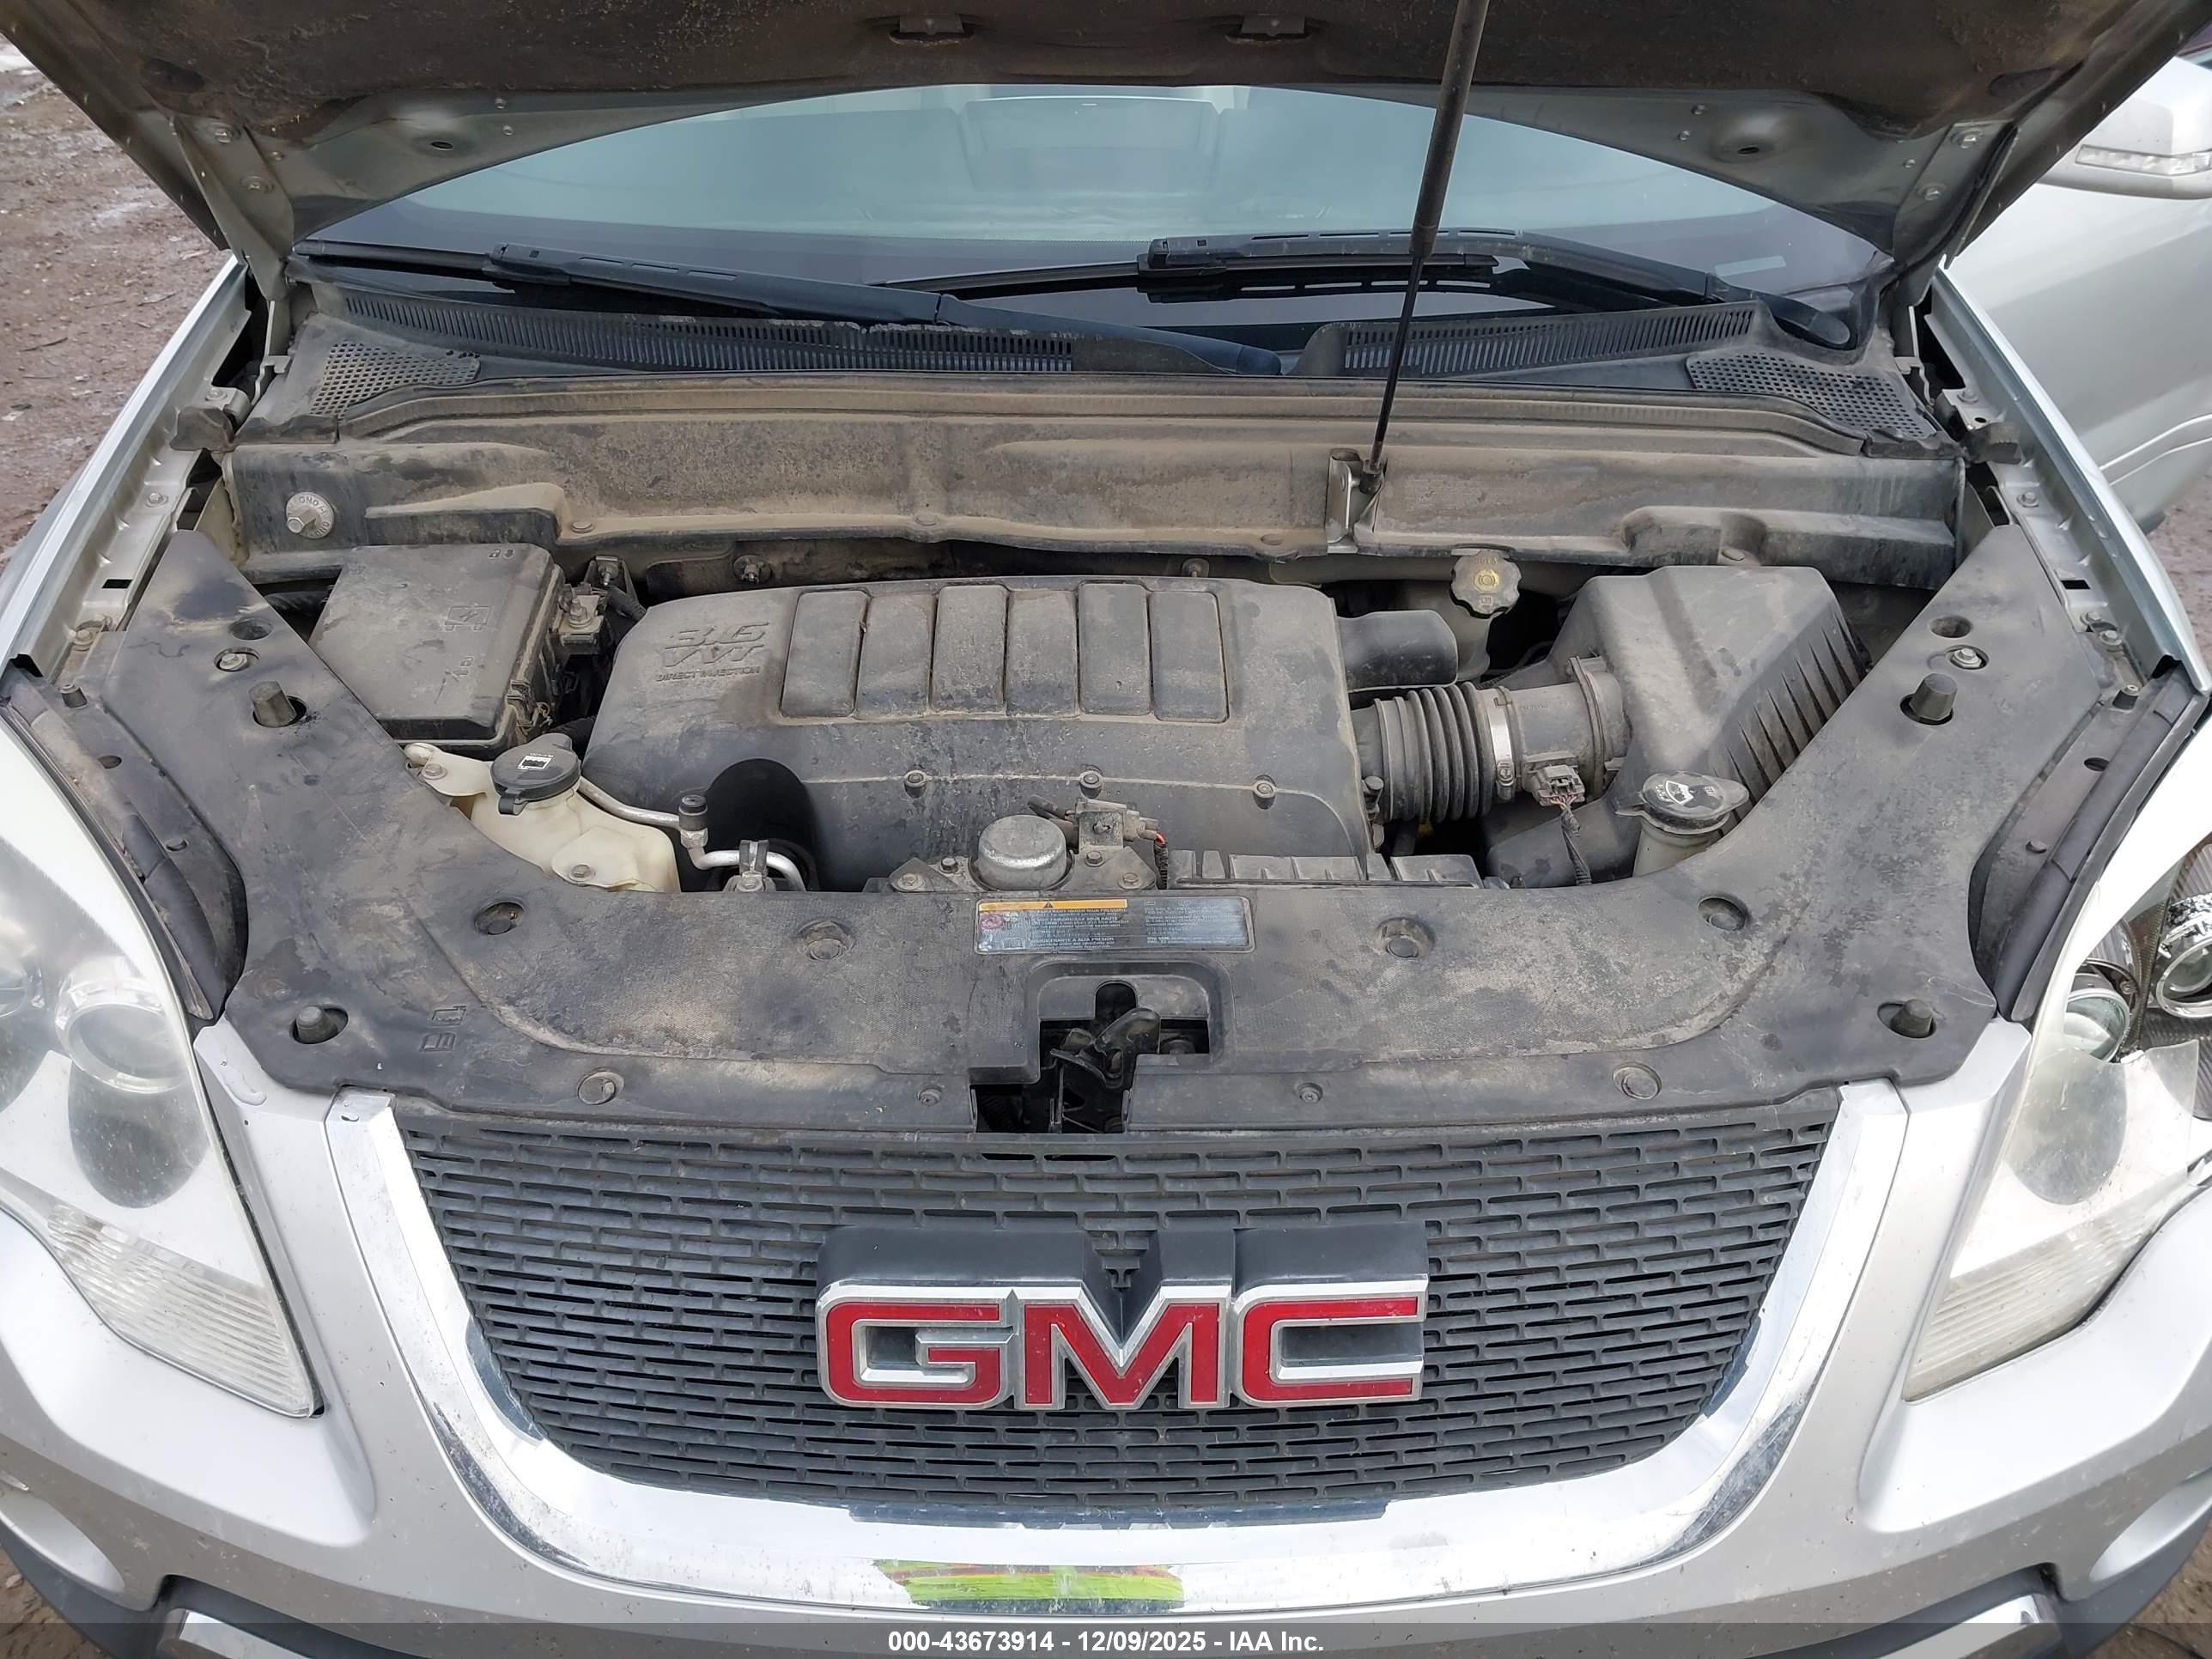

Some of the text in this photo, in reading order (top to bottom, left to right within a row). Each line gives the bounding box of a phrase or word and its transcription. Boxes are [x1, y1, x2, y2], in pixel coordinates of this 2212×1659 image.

[655, 665, 761, 683] DIRECT INJECTION
[816, 1276, 1429, 1410] GMC
